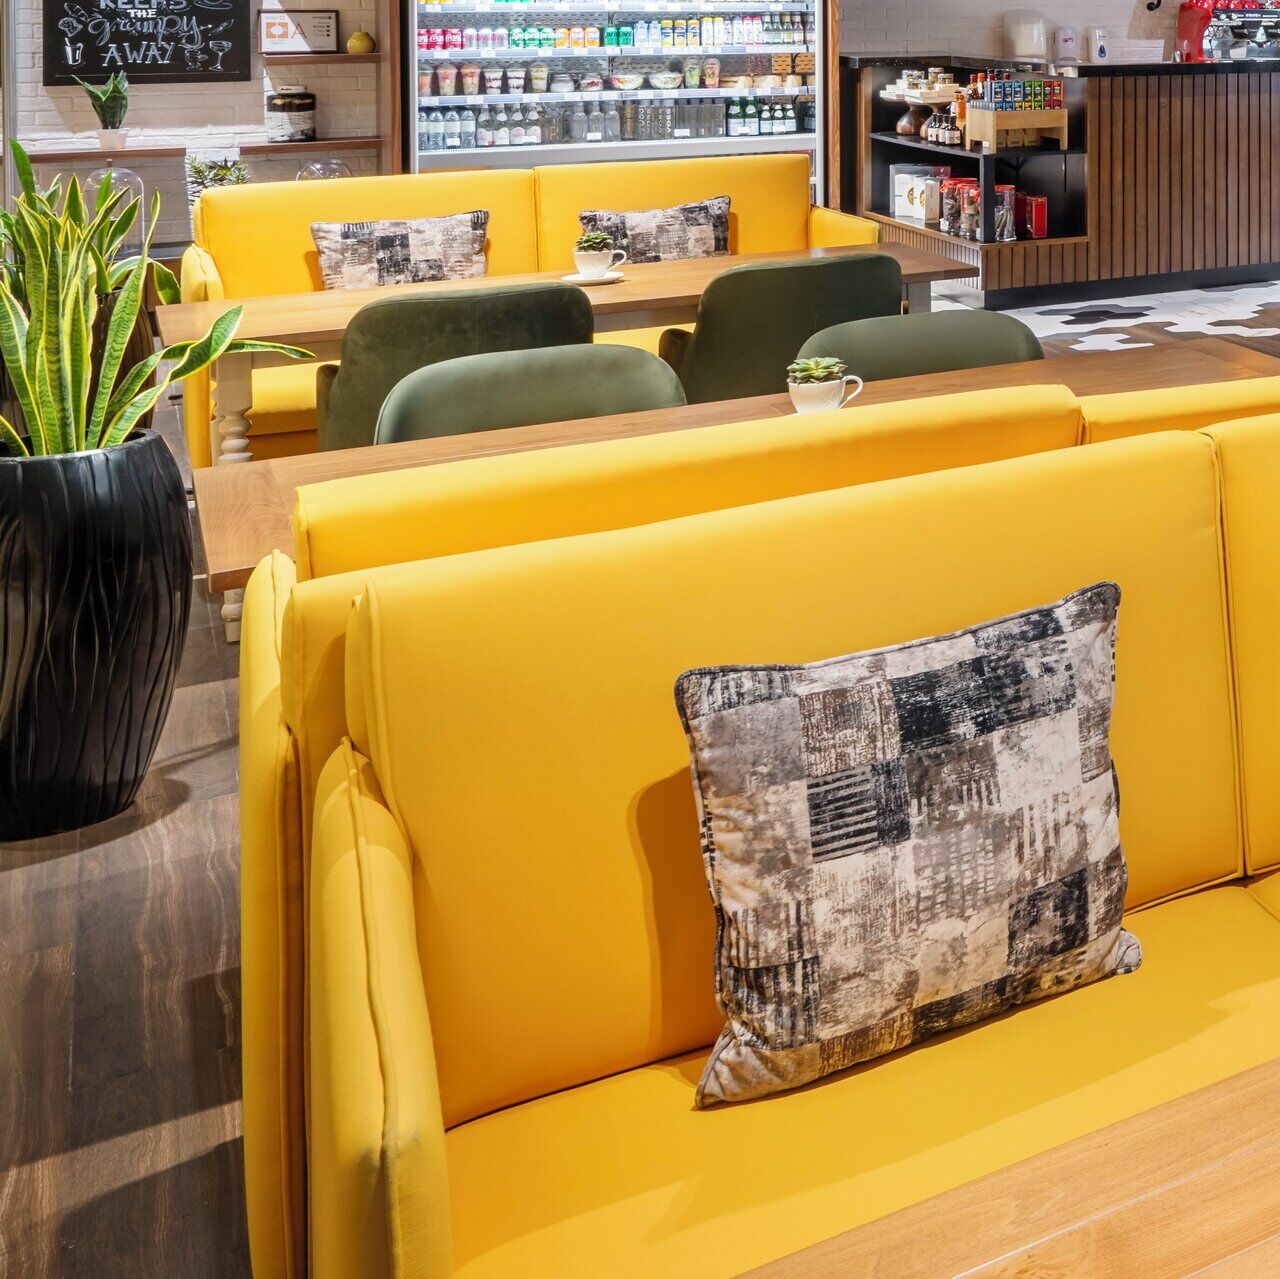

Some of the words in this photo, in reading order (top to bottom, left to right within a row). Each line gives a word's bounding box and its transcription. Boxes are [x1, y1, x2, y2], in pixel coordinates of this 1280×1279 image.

[126, 9, 157, 18] THE
[88, 15, 202, 49] grumpy
[291, 23, 307, 39] A
[100, 41, 176, 67] AWAY
